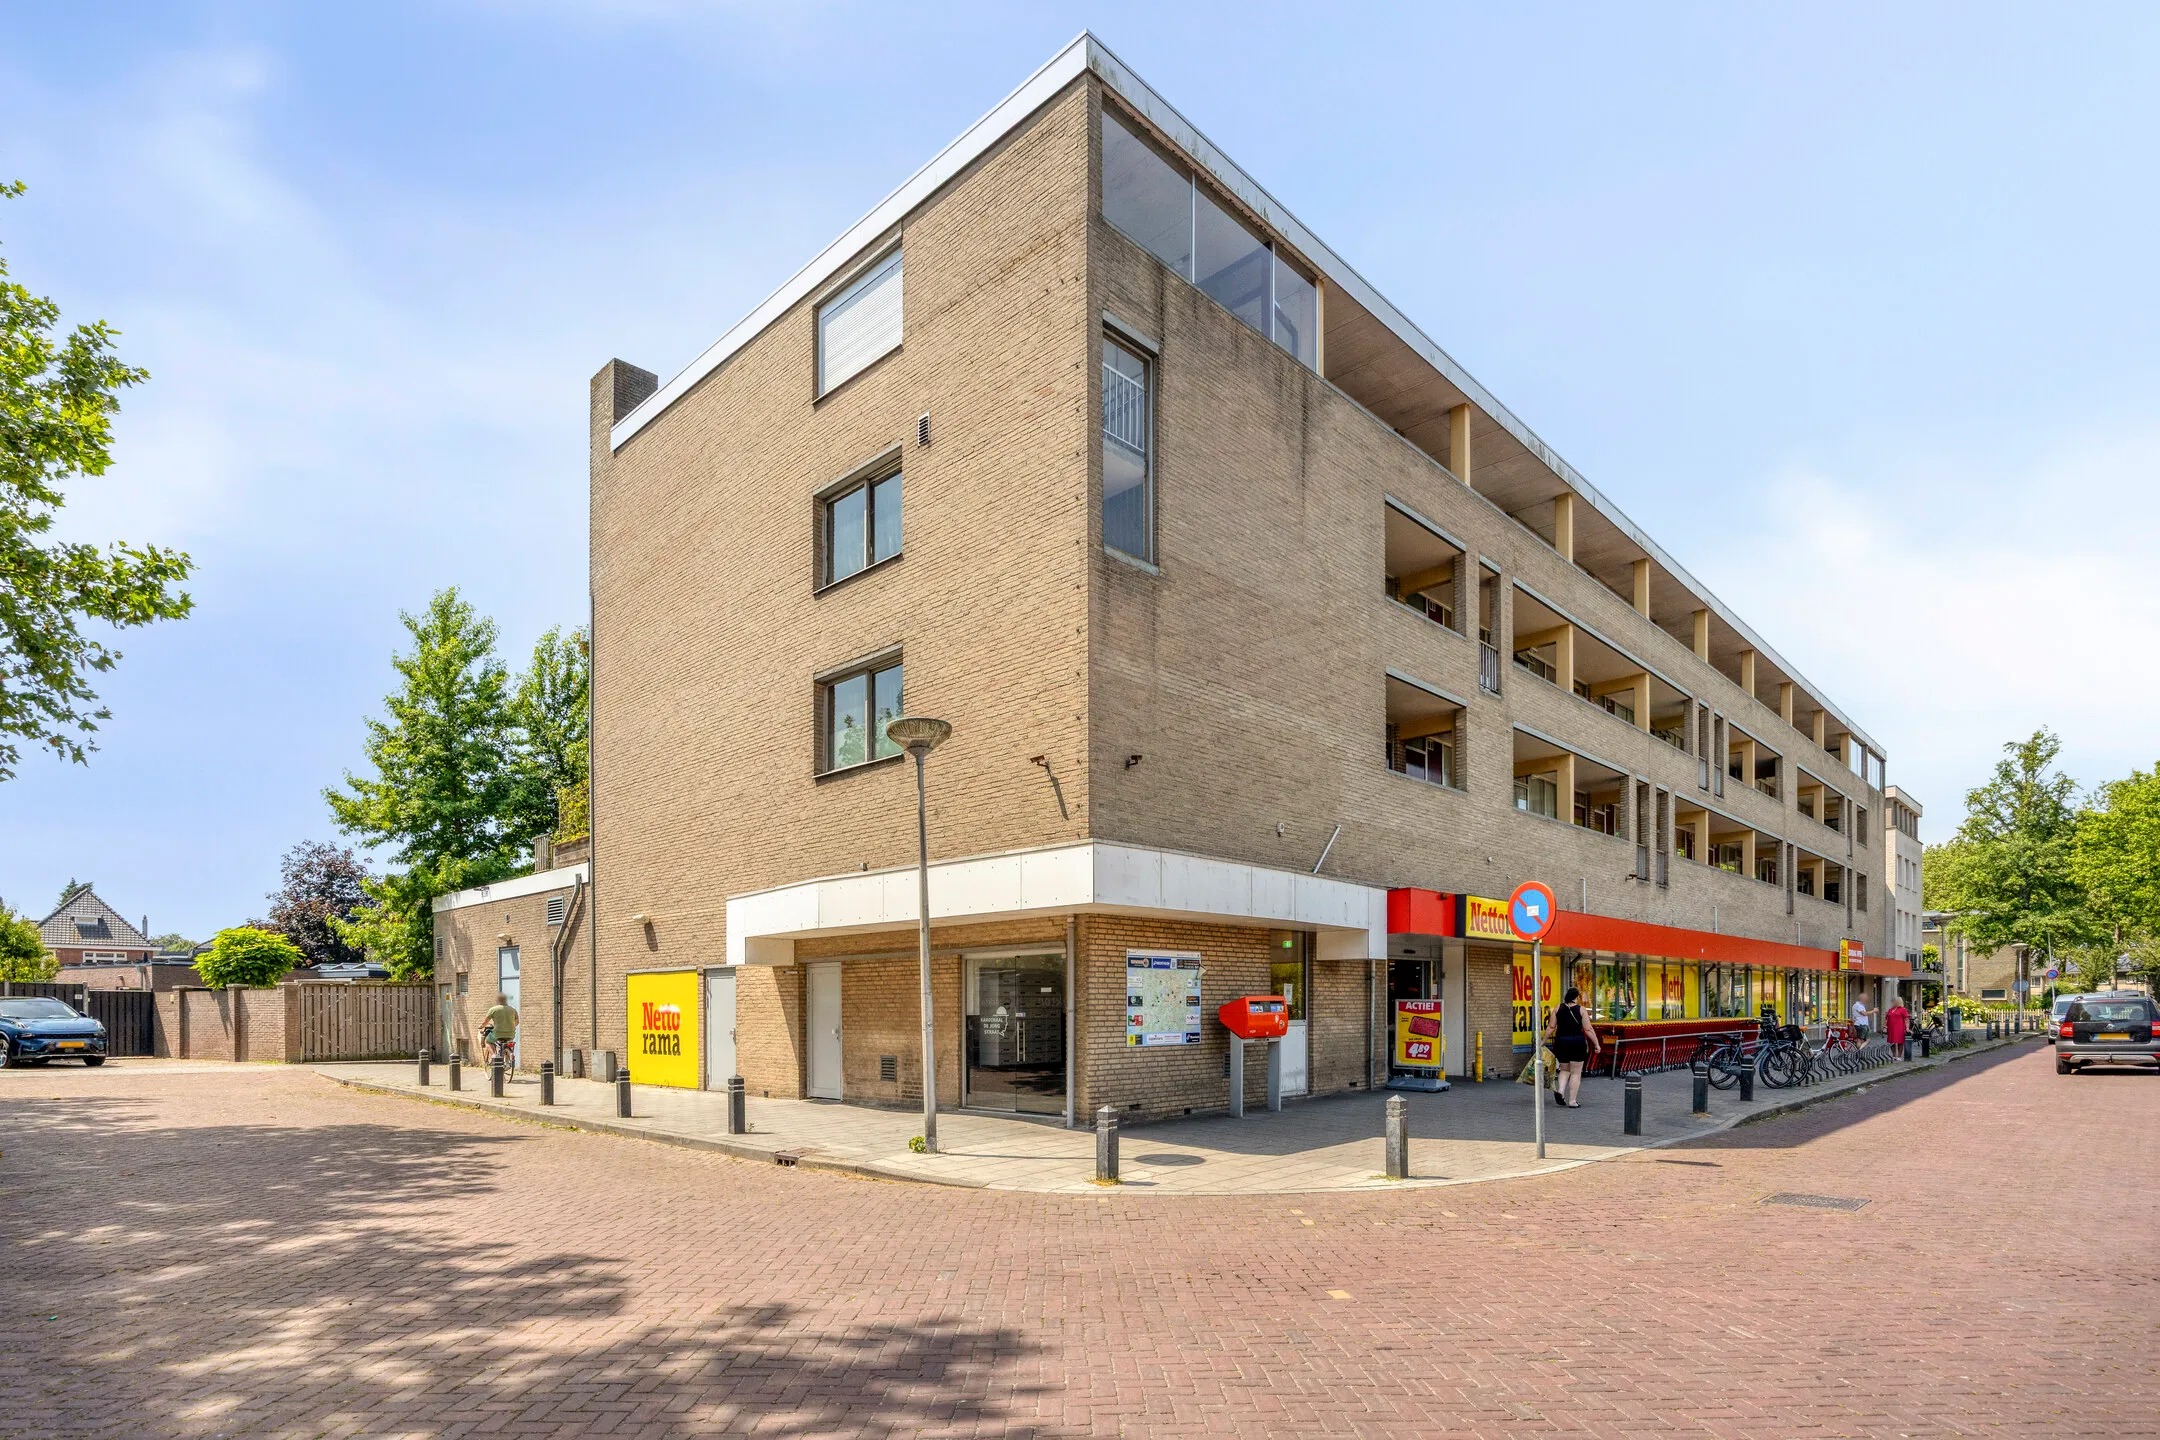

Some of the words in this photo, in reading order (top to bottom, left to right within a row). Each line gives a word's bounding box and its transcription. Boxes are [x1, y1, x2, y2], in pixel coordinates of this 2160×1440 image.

[1513, 966, 1552, 1001] Neto
[642, 1002, 681, 1031] Netto
[1405, 1001, 1435, 1011] ACTIE!
[642, 1033, 681, 1056] rama
